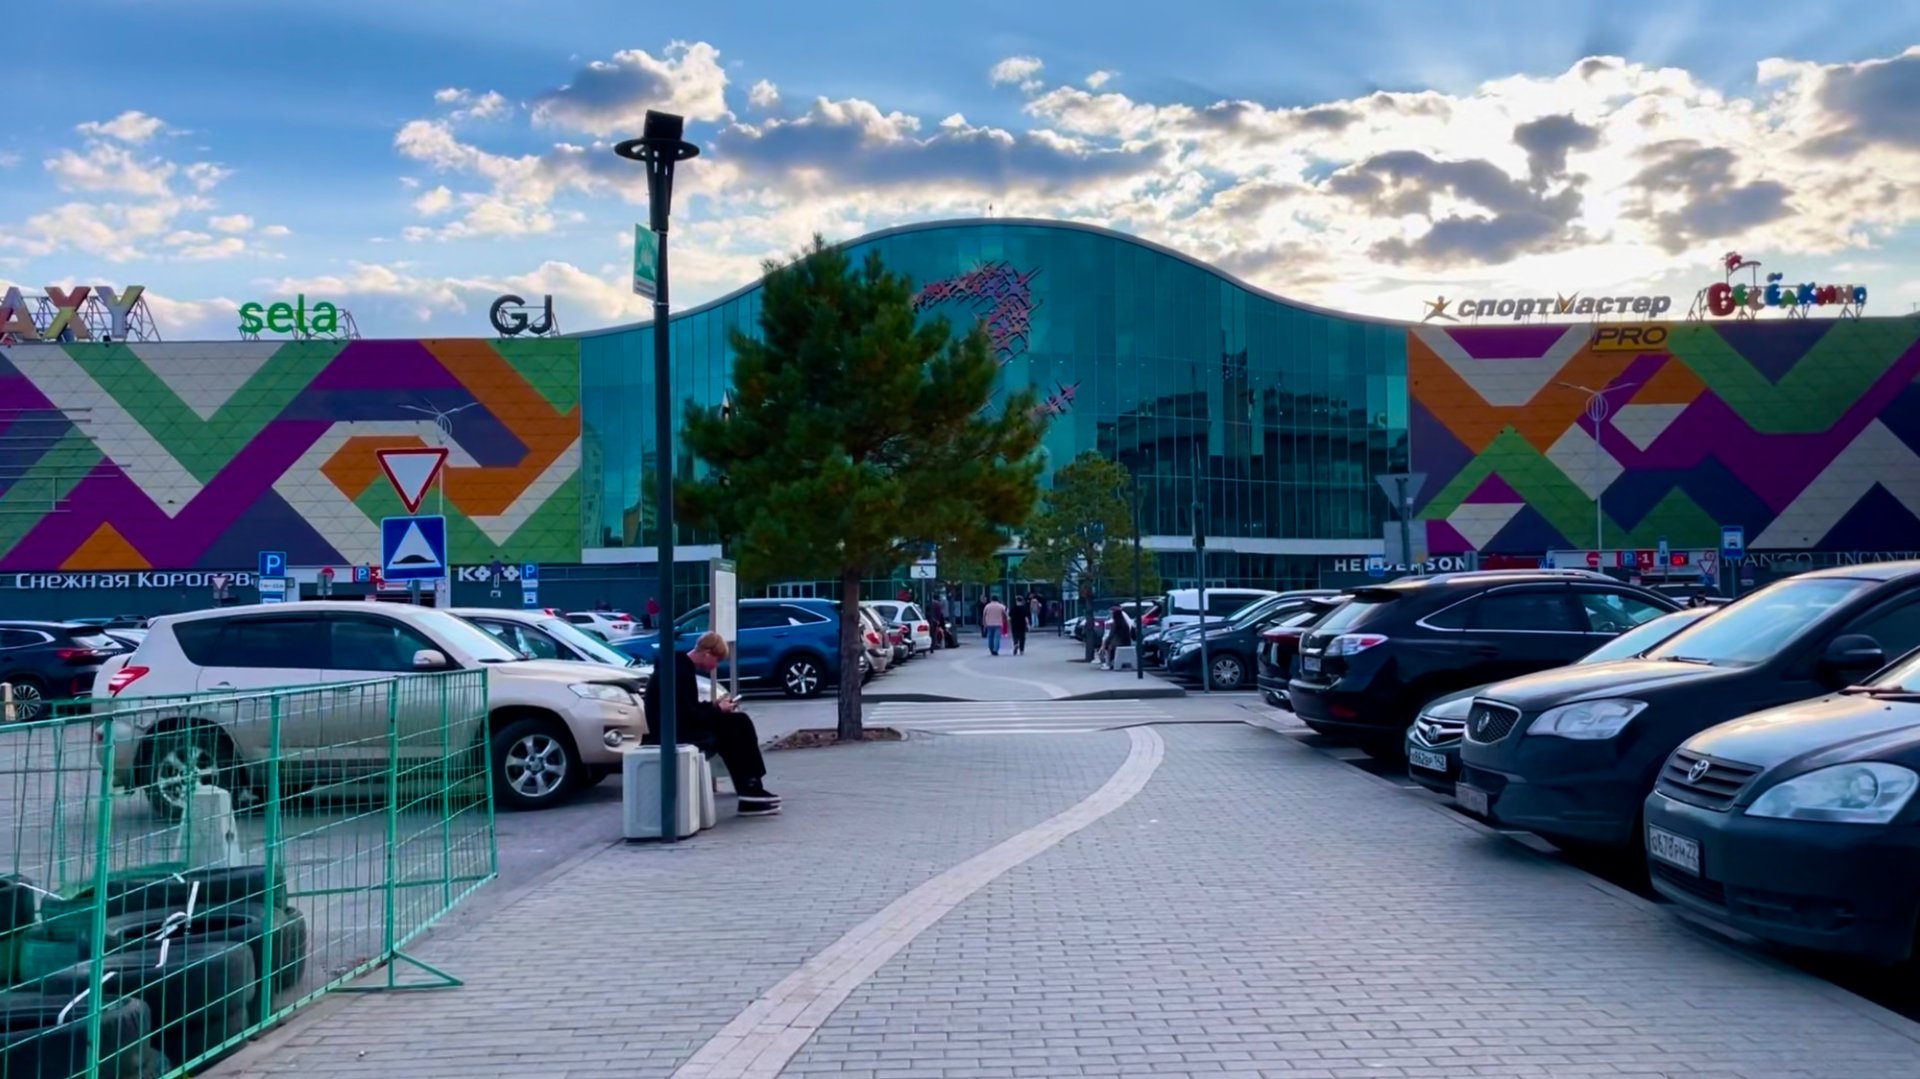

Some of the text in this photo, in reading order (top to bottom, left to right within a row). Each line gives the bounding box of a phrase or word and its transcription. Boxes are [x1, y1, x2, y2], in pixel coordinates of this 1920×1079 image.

[240, 293, 337, 333] sela
[490, 294, 552, 335] GJ
[1593, 327, 1668, 346] PRO
[266, 554, 281, 575] P
[526, 564, 535, 578] P
